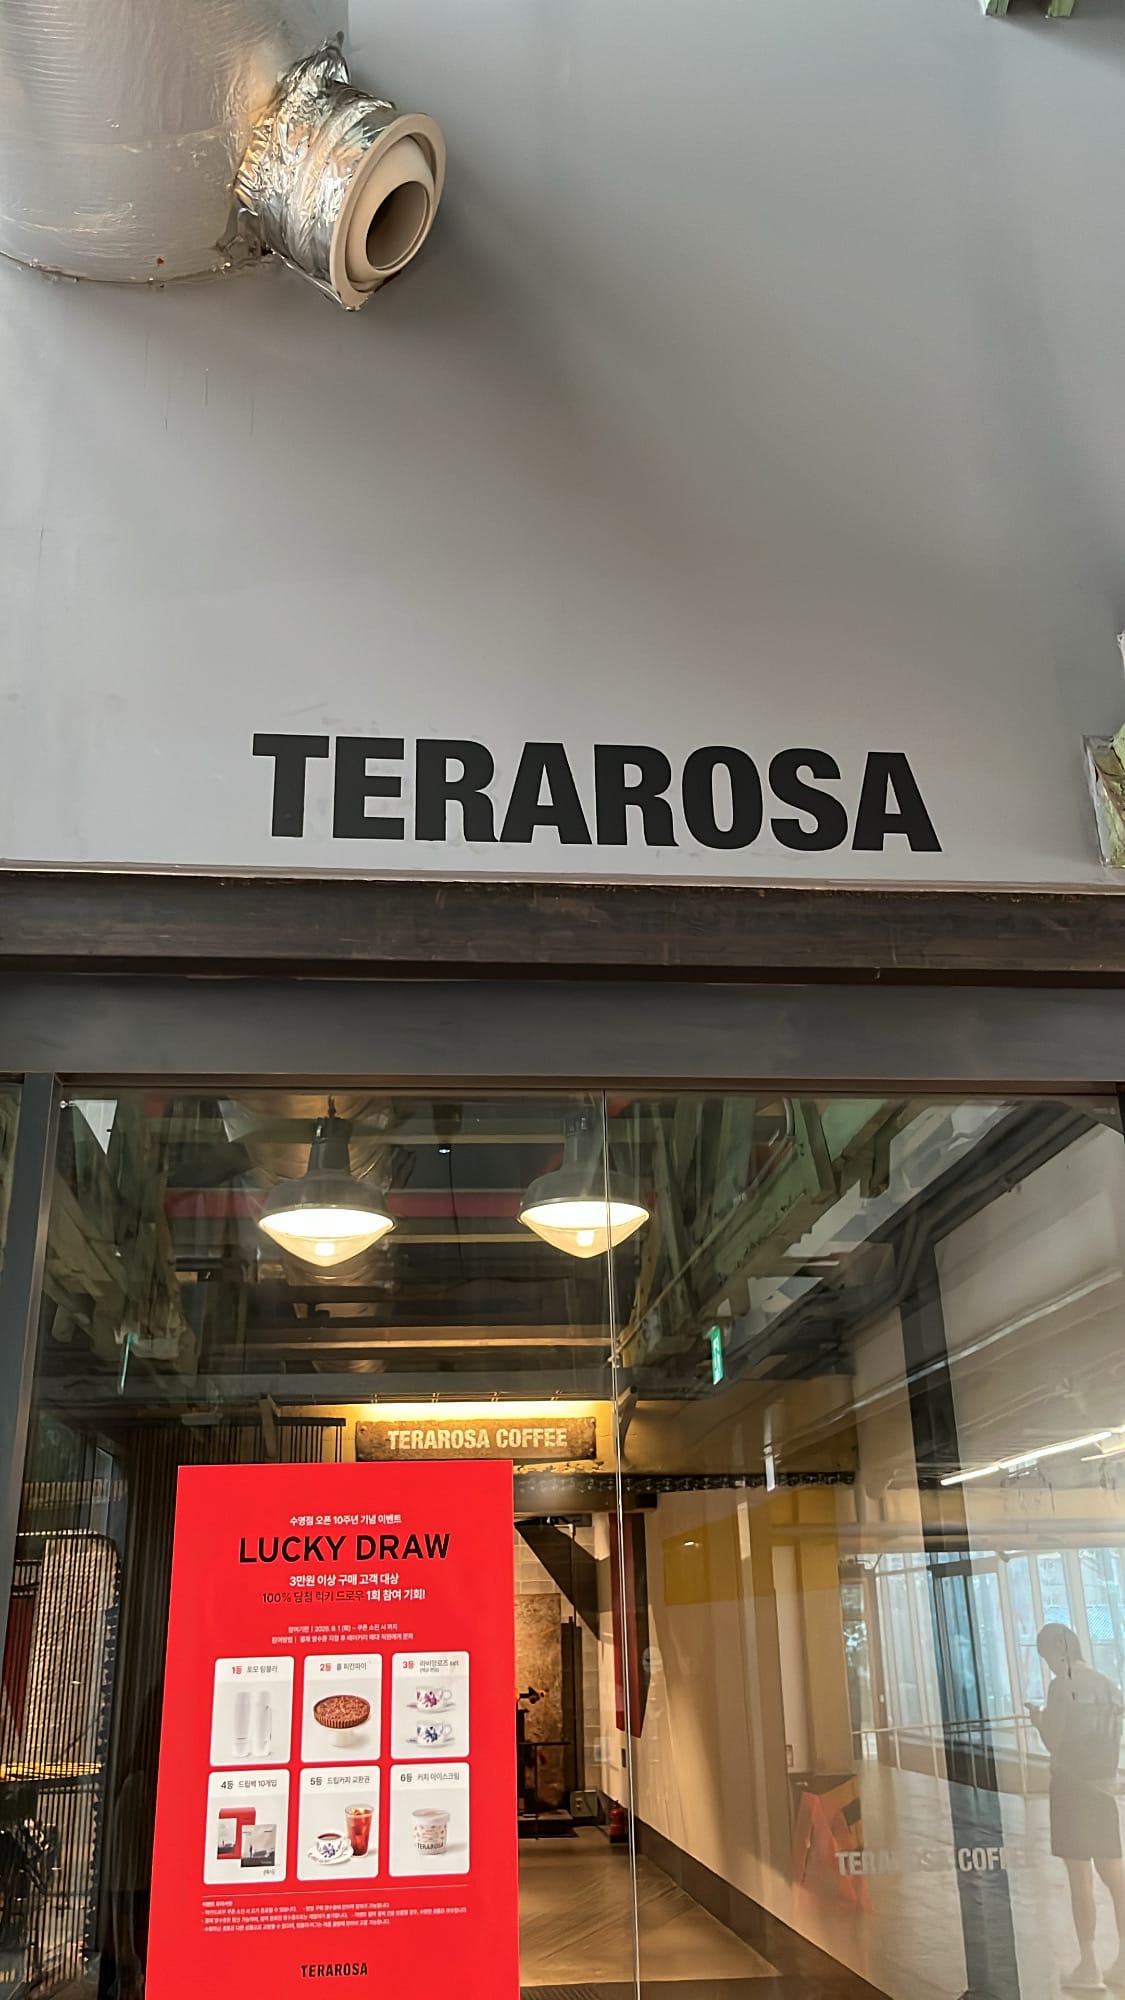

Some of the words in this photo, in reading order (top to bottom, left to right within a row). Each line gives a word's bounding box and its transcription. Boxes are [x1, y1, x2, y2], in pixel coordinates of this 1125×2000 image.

[252, 733, 943, 852] TERAROSA
[387, 1429, 490, 1450] TERAROSA
[496, 1427, 568, 1448] COFFEE
[289, 1515, 314, 1527] 수영점
[316, 1515, 331, 1526] 오픈
[333, 1514, 359, 1526] 10주년
[360, 1514, 377, 1525] 기념
[378, 1513, 402, 1525] 이벤트
[239, 1535, 347, 1563] LUCKY
[356, 1533, 451, 1561] DRAW
[289, 1574, 315, 1587] 3만원
[317, 1574, 337, 1587] 이상
[338, 1574, 358, 1586] 구매
[360, 1573, 378, 1586] 고객
[380, 1572, 400, 1585] 대상
[262, 1592, 292, 1603] 100%
[294, 1591, 313, 1603] 당첨
[336, 1590, 365, 1602] 드로우
[366, 1589, 381, 1601] 1회
[383, 1588, 402, 1601] 참여
[403, 1588, 426, 1600] 기회!
[402, 1660, 415, 1670] 3등
[220, 1780, 234, 1790] 4등
[310, 1776, 323, 1786] 5등
[400, 1773, 413, 1783] 6등
[301, 1962, 369, 1979] TERAROSA
